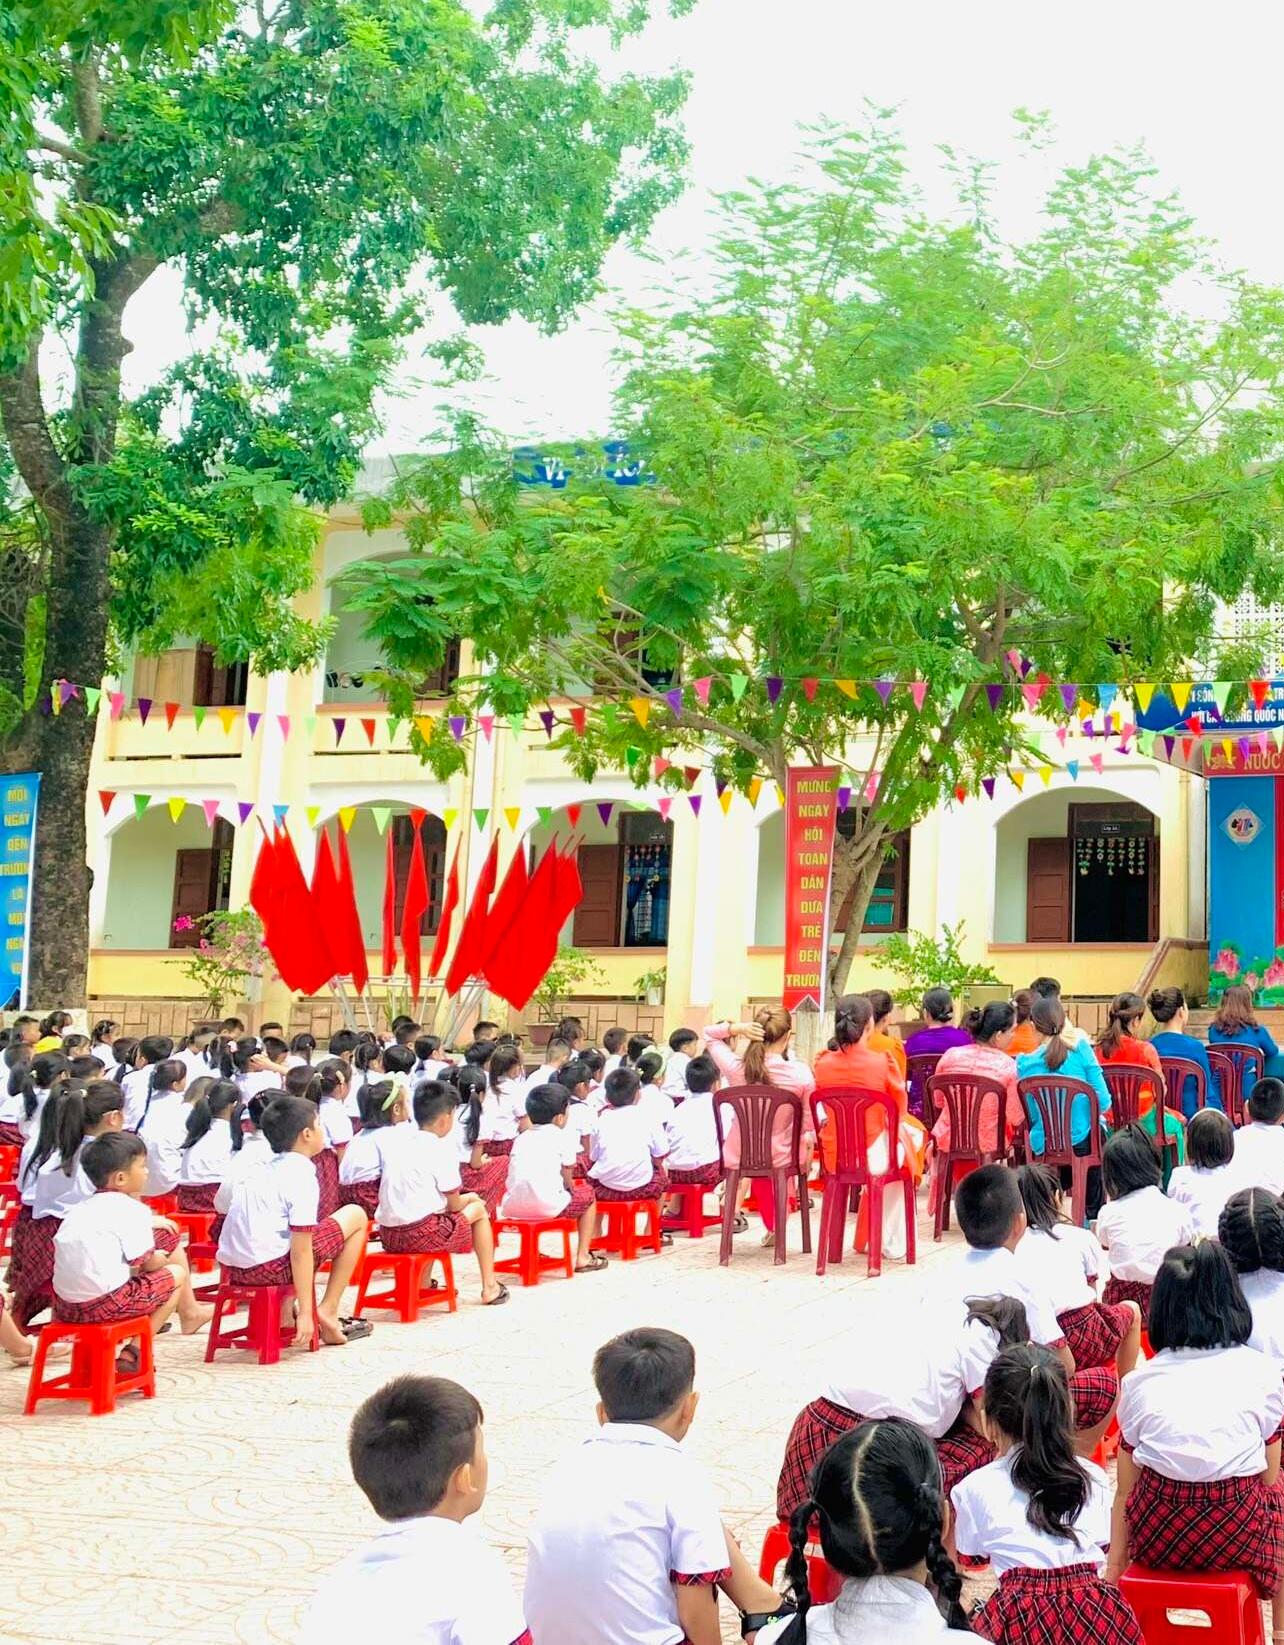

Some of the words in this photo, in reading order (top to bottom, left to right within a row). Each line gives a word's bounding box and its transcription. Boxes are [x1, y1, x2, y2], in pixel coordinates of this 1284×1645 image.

[1254, 703, 1276, 723] QUỐC
[1243, 750, 1281, 770] NƯỚC
[797, 779, 832, 794] MỪNG
[798, 803, 830, 817] NGÀY
[804, 826, 823, 842] HỘI
[799, 851, 828, 866] TOÀN
[800, 874, 824, 890] DÂN
[800, 900, 823, 914] ĐƯA
[800, 921, 822, 938] TRẺ
